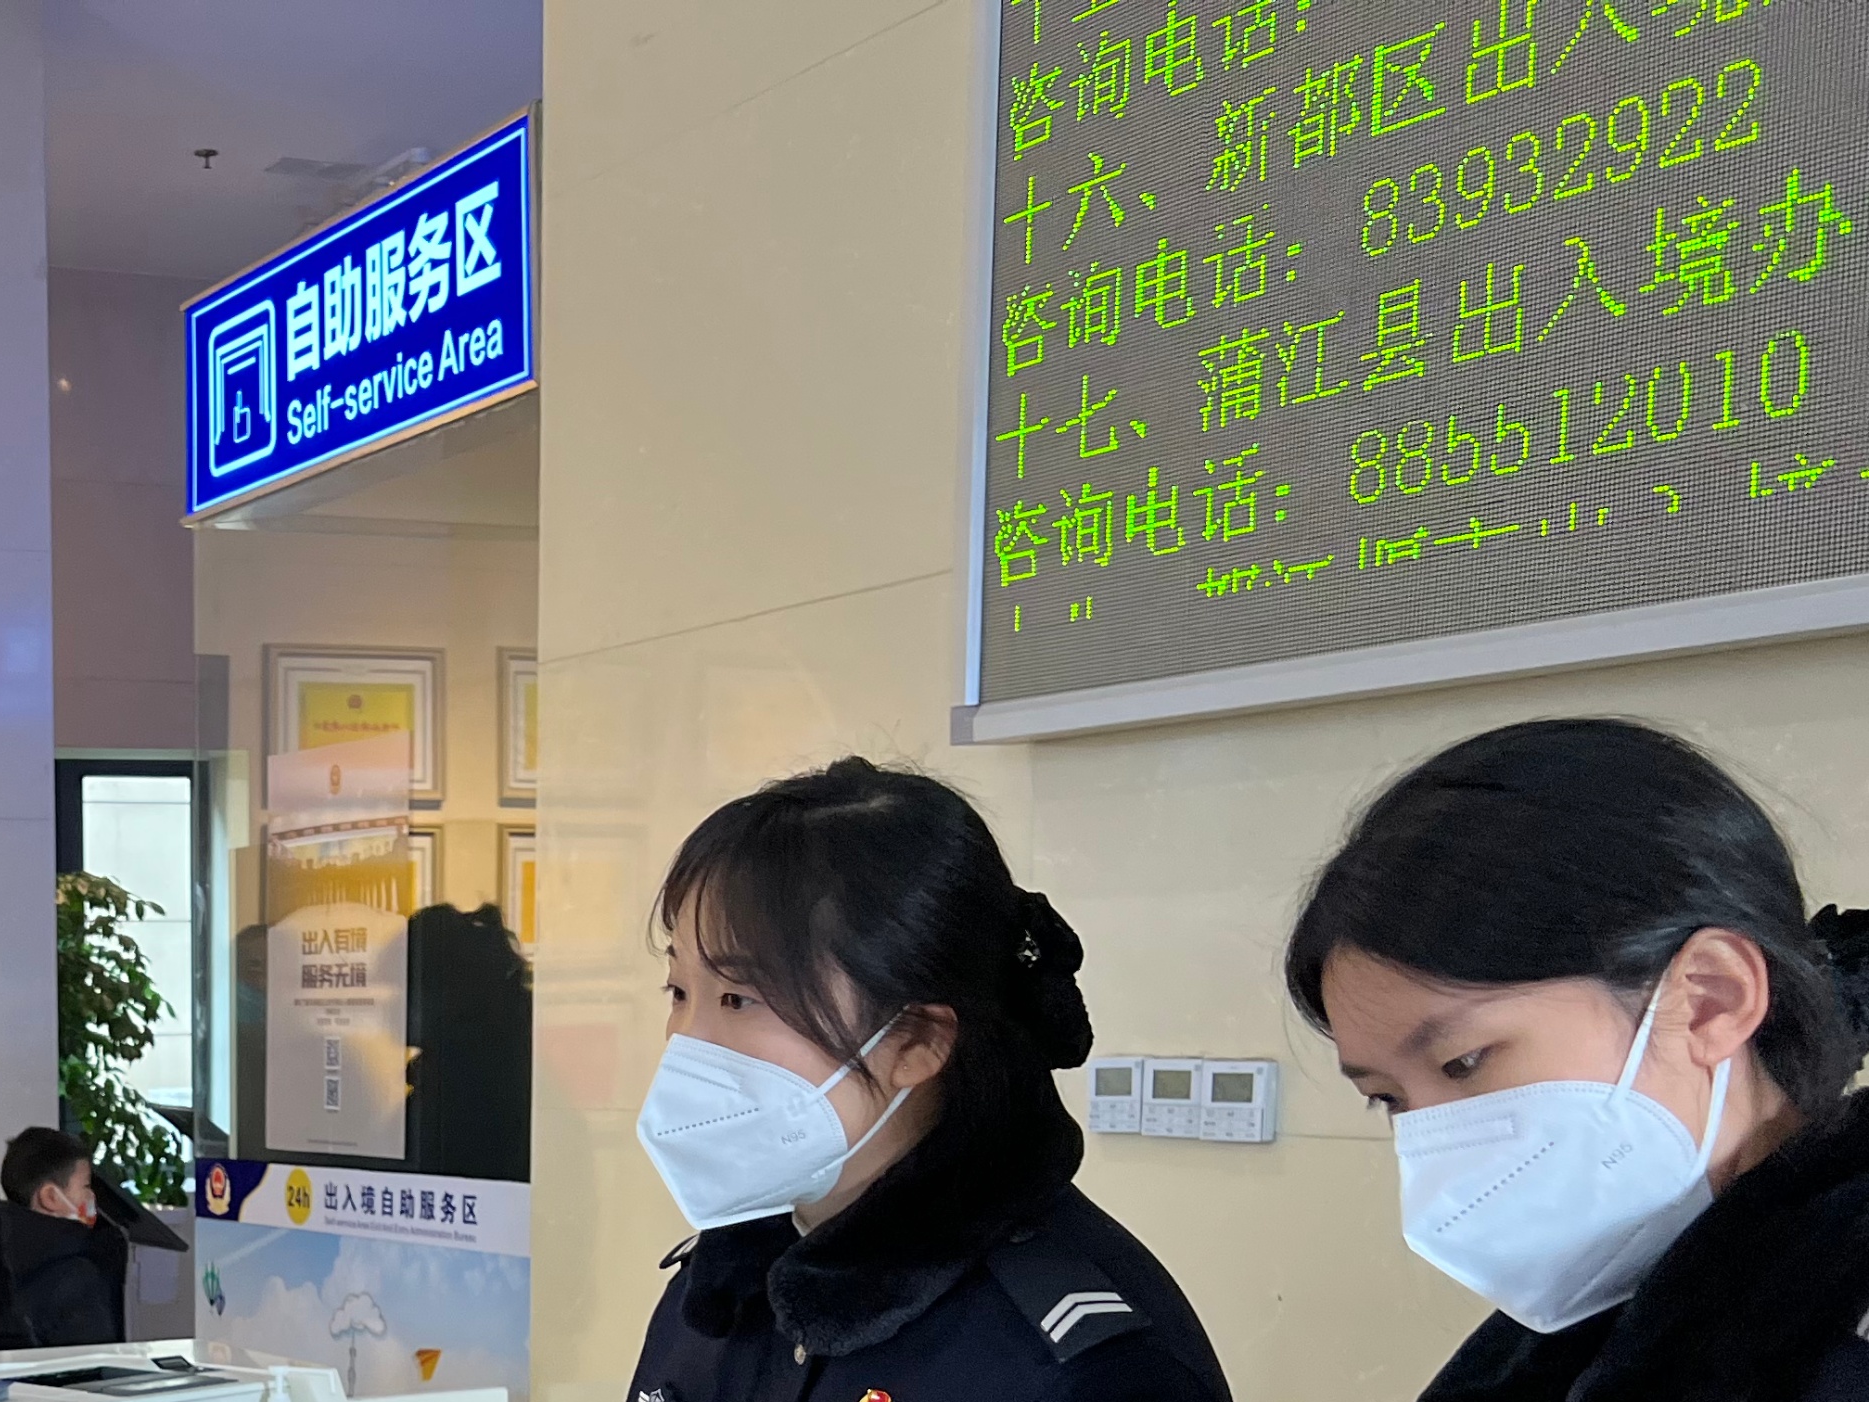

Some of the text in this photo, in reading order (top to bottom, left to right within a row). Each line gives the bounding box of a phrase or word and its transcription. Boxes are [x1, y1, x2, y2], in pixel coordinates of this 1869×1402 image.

[286, 180, 502, 382] 自助服务区
[287, 318, 503, 445] Self-service Area
[301, 927, 368, 956] 出入有境
[301, 962, 367, 989] 服务无境
[287, 1184, 311, 1209] 24h
[324, 1181, 478, 1226] 出入境自助服务区
